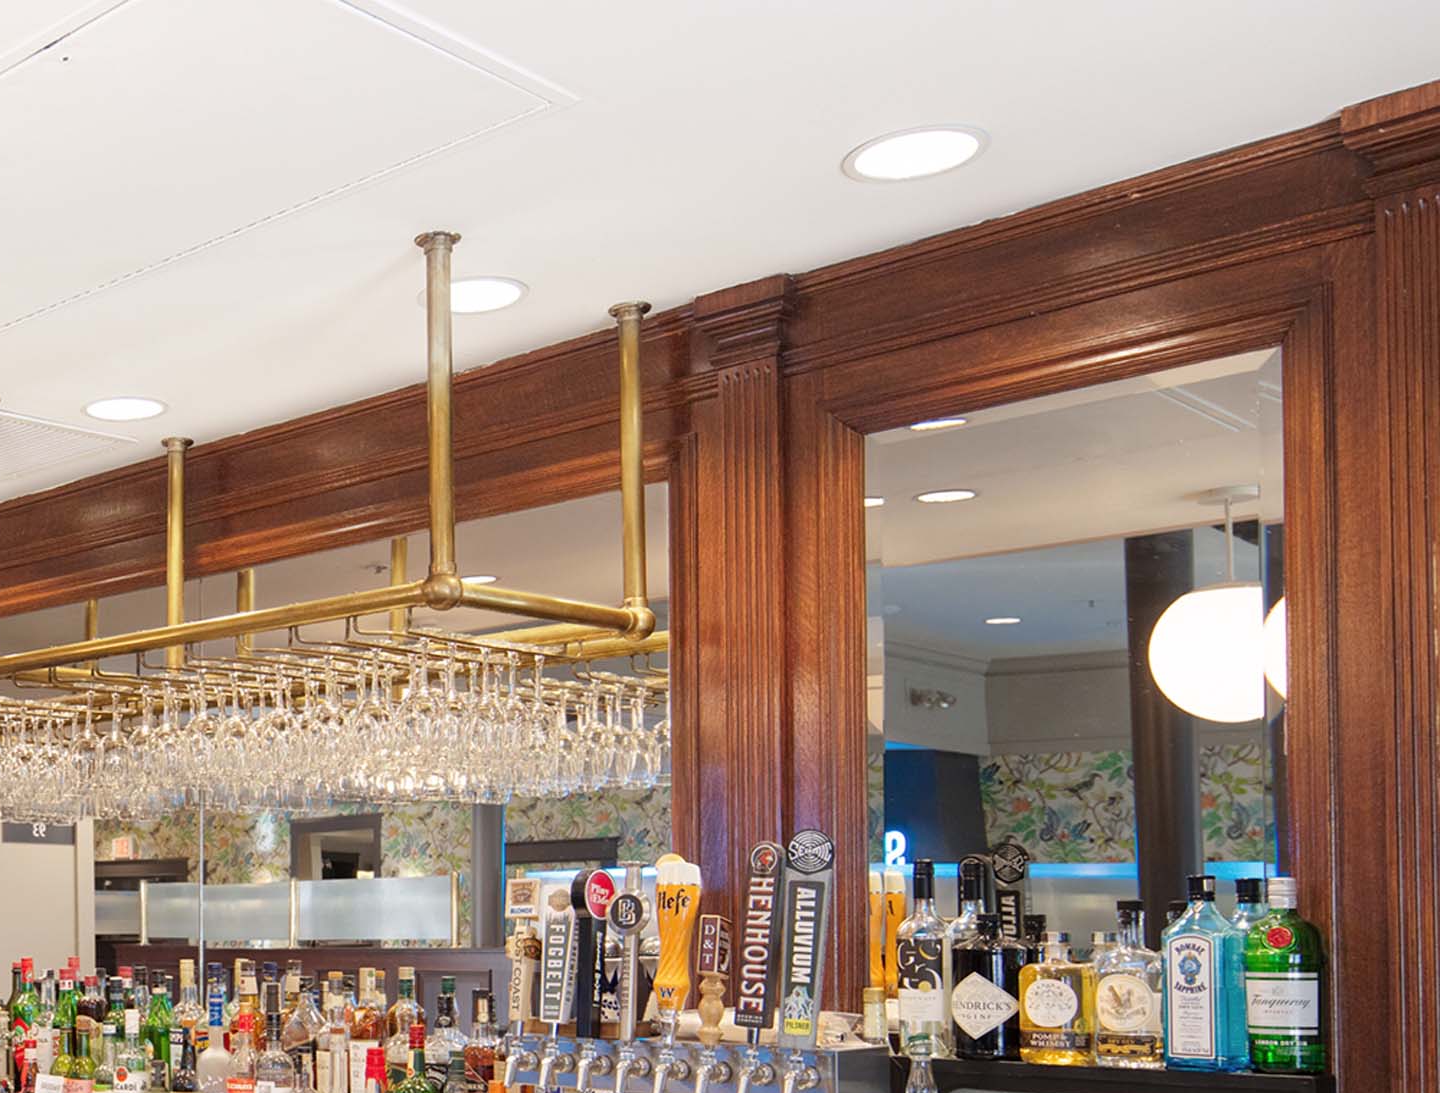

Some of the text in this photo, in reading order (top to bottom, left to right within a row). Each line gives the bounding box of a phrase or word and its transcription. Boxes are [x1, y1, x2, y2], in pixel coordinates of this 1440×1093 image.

[740, 877, 775, 1012] HENHOUSE
[791, 887, 816, 984] ALLUVIUM
[1174, 943, 1205, 955] BOMBAY
[545, 924, 566, 999] FOGBELT
[512, 967, 522, 1011] COAST
[1174, 981, 1207, 994] SAPPHIRE
[1251, 994, 1311, 1009] Tanqueray
